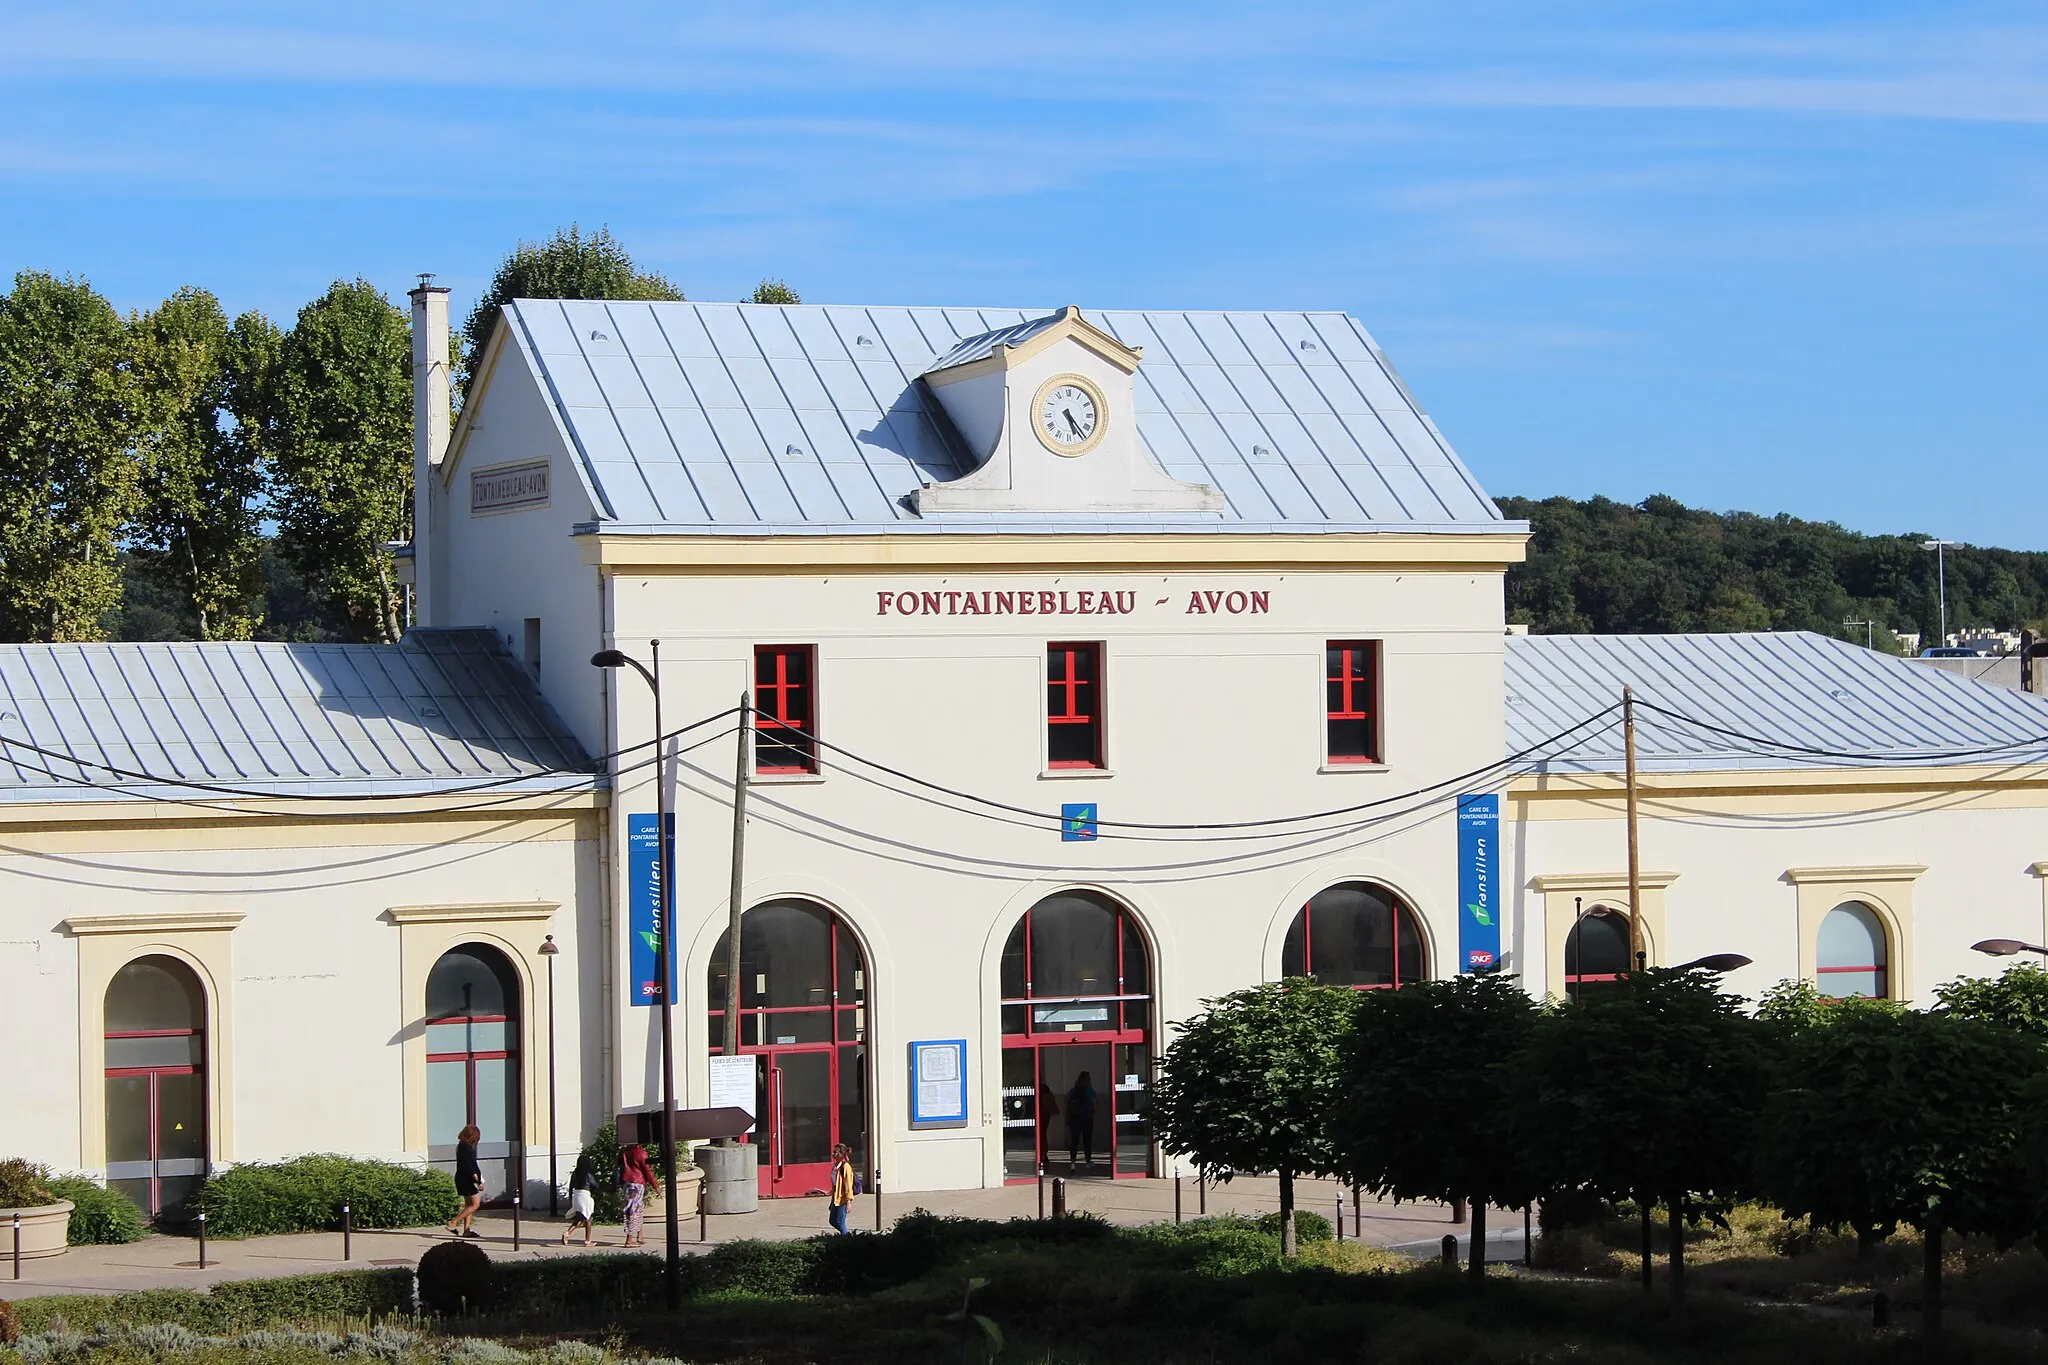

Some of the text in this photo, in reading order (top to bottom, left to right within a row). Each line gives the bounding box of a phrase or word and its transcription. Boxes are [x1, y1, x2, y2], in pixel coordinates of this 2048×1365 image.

[876, 591, 1137, 616] FONTAINEBLEAU
[1184, 590, 1271, 615] AVON
[649, 860, 662, 946] Transilien
[1475, 838, 1487, 918] Transilien
[1470, 954, 1492, 963] SNCF
